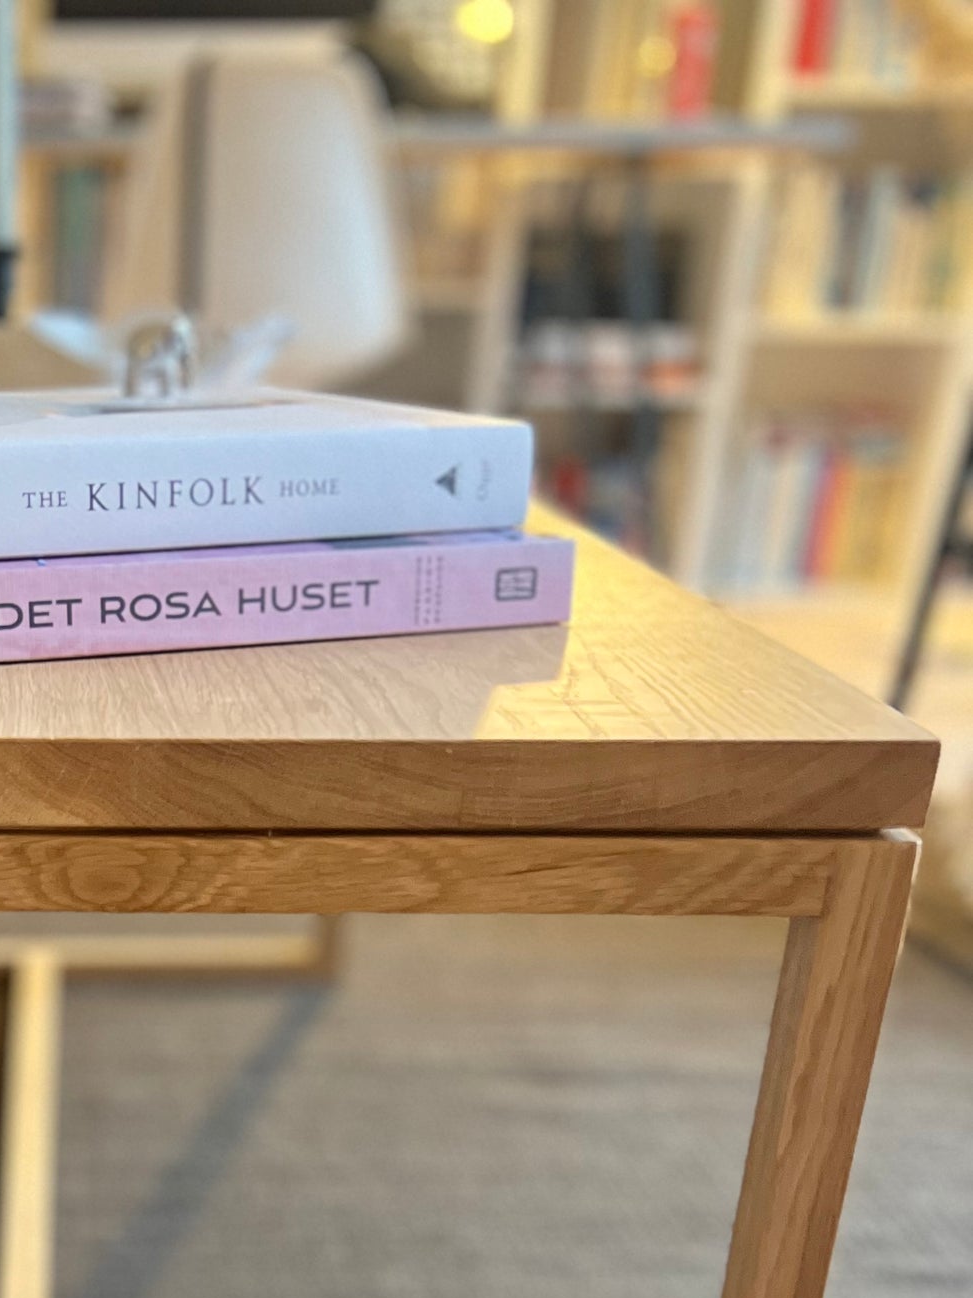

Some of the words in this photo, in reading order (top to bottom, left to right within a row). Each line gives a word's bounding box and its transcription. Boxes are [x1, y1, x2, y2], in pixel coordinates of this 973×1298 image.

[22, 491, 68, 509] THE
[87, 476, 265, 511] KINFOLK
[279, 478, 341, 498] HOME
[100, 592, 222, 624] ROSA
[237, 580, 380, 614] HUSET
